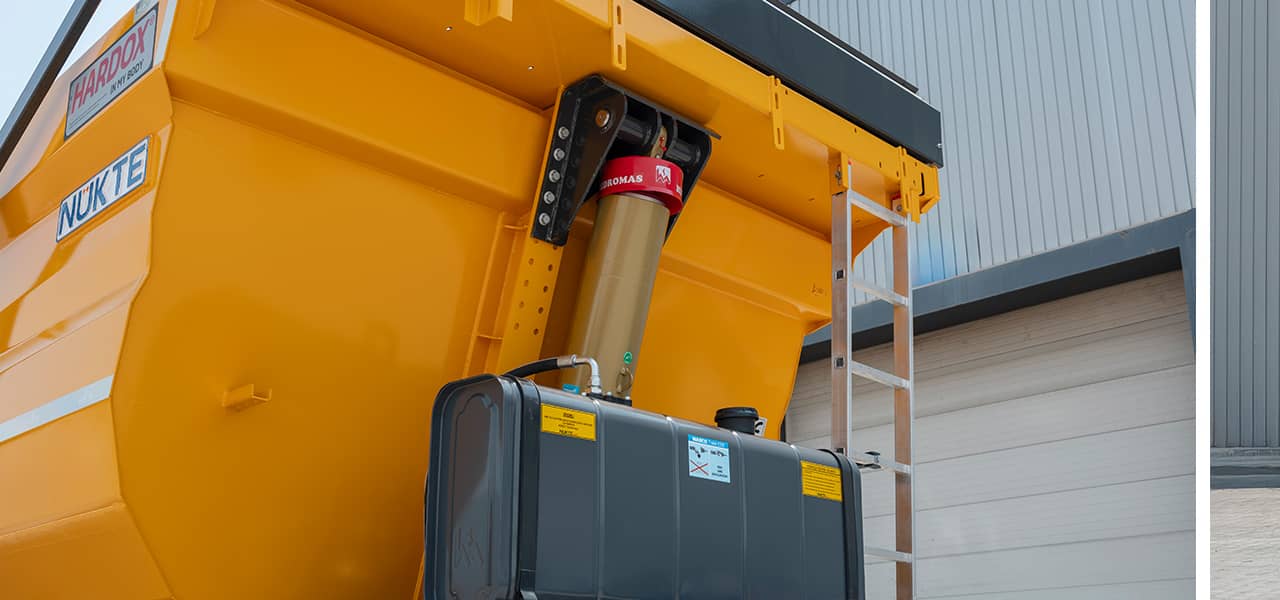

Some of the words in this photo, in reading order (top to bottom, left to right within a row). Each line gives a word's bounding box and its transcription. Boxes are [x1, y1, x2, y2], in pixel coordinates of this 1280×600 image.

[71, 18, 151, 114] HARDOX
[116, 73, 127, 90] MY
[126, 61, 145, 80] BODY
[59, 142, 147, 236] NÜKTE
